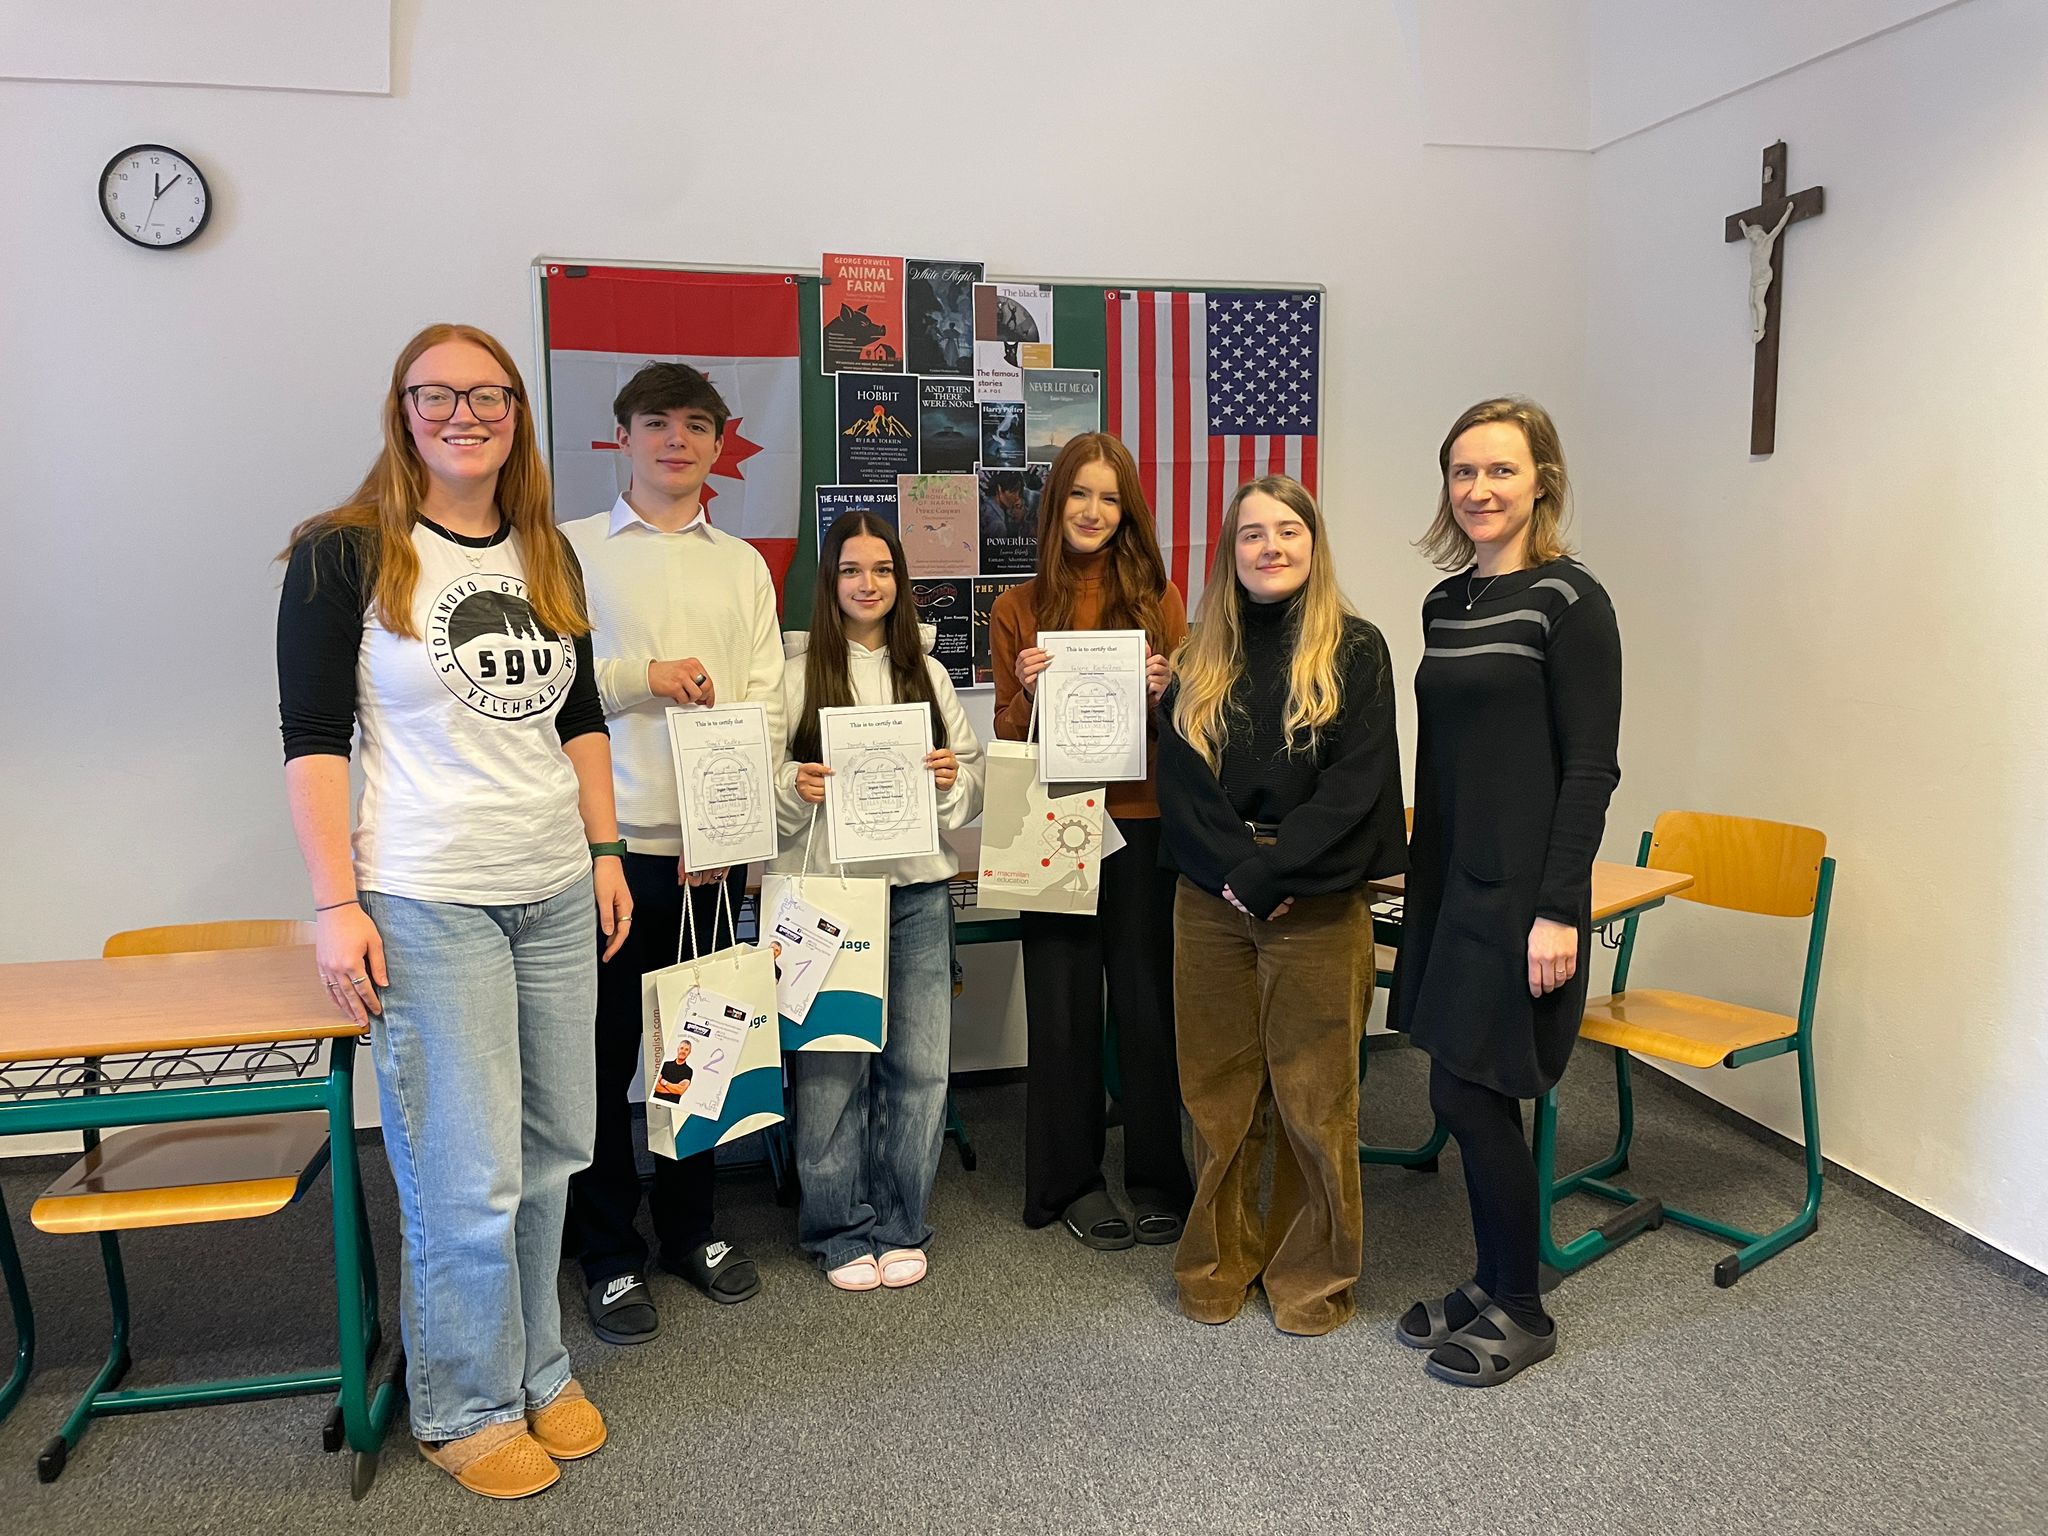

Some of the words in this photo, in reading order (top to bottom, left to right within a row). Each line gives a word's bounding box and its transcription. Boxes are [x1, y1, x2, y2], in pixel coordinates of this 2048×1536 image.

[150, 157, 160, 165] 12
[119, 173, 128, 181] 10
[112, 192, 118, 200] 9
[120, 212, 126, 220] 8
[156, 232, 161, 240] 6
[176, 227, 182, 235] 5
[834, 257, 861, 265] GEORGE
[862, 258, 891, 267] ORWELL
[838, 265, 894, 281] ANIMAL
[909, 267, 939, 281] White
[942, 269, 976, 285] Nights
[847, 280, 886, 293] FARM
[1002, 288, 1018, 297] The
[1019, 289, 1038, 298] black
[1039, 290, 1051, 298] cat
[976, 369, 990, 378] The
[991, 368, 1019, 378] famous
[924, 385, 945, 393] AND
[946, 385, 971, 393] THEN
[1029, 381, 1055, 392] NEVER
[1055, 382, 1068, 393] LET
[1069, 383, 1080, 393] ME
[1081, 383, 1094, 393] GO
[857, 390, 900, 402] HOBBIT
[948, 400, 975, 408] NONE
[983, 406, 1003, 414] Harry
[820, 495, 832, 504] THE
[833, 494, 853, 503] FAULT
[855, 494, 862, 503] IN
[862, 494, 875, 503] OUR
[876, 494, 897, 503] STARS
[974, 585, 994, 593] THE
[432, 581, 478, 674] STOJANOVO
[467, 684, 556, 714] VELEHRAD
[996, 870, 1030, 878] macmillan
[996, 876, 1029, 885] education
[702, 1047, 726, 1075] 2
[706, 1240, 728, 1258] NIKE
[607, 1275, 635, 1296] NIKE
